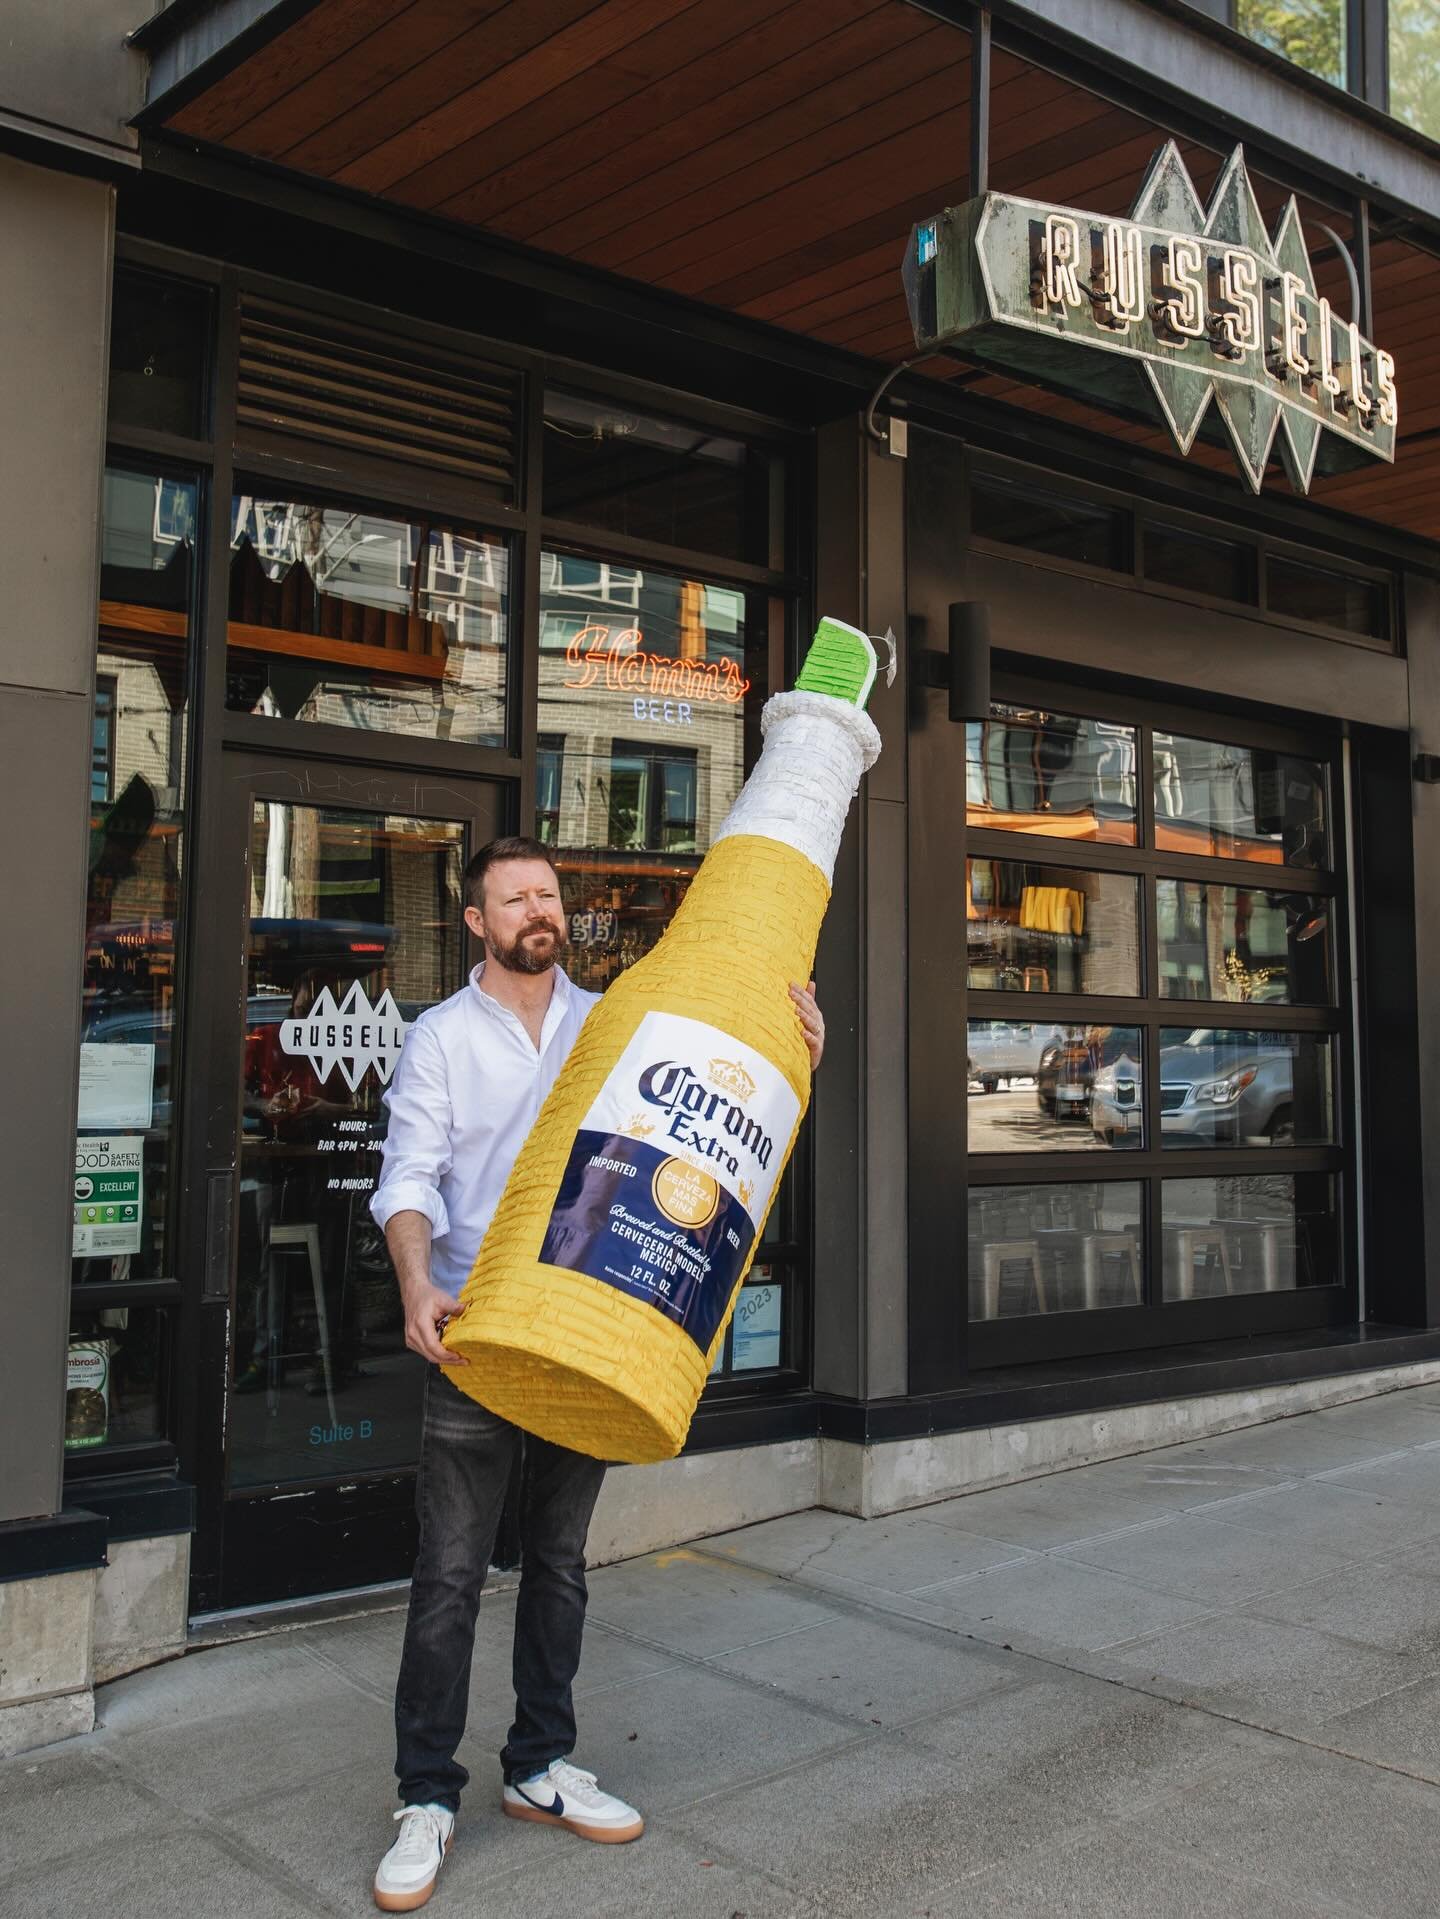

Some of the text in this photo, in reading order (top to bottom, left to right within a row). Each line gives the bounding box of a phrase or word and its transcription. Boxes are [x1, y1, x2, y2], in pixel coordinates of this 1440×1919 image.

[1029, 214, 1398, 428] RUSSELLS
[564, 625, 750, 703] Hamm's
[633, 698, 692, 725] BEER
[293, 1024, 402, 1049] RUSSELL
[339, 1121, 368, 1132] HOURS
[638, 1060, 773, 1171] Corona
[317, 1140, 336, 1151] BAR
[337, 1141, 358, 1152] 4PM
[666, 1110, 739, 1177] Extra
[75, 1153, 110, 1168] OOD
[110, 1153, 140, 1161] SAFETY
[110, 1159, 140, 1167] RATING
[588, 1155, 638, 1178] IMPORTED
[99, 1181, 136, 1193] EXCELLENT
[327, 1178, 375, 1190] NO MINORS
[663, 1171, 713, 1206] CERVEZA
[685, 1169, 701, 1185] LA
[669, 1197, 694, 1217] FINA
[672, 1187, 698, 1207] MAS
[609, 1204, 712, 1273] Brewed and Bottled by
[726, 1227, 741, 1250] BEER
[611, 1221, 705, 1284] CERVECERIA MODELO
[640, 1248, 678, 1276] MEXICO
[630, 1265, 671, 1296] 12 FL. OZ.
[740, 1287, 772, 1322] 2023
[68, 1357, 100, 1367] mbrosia
[310, 1420, 373, 1445] Suite B
